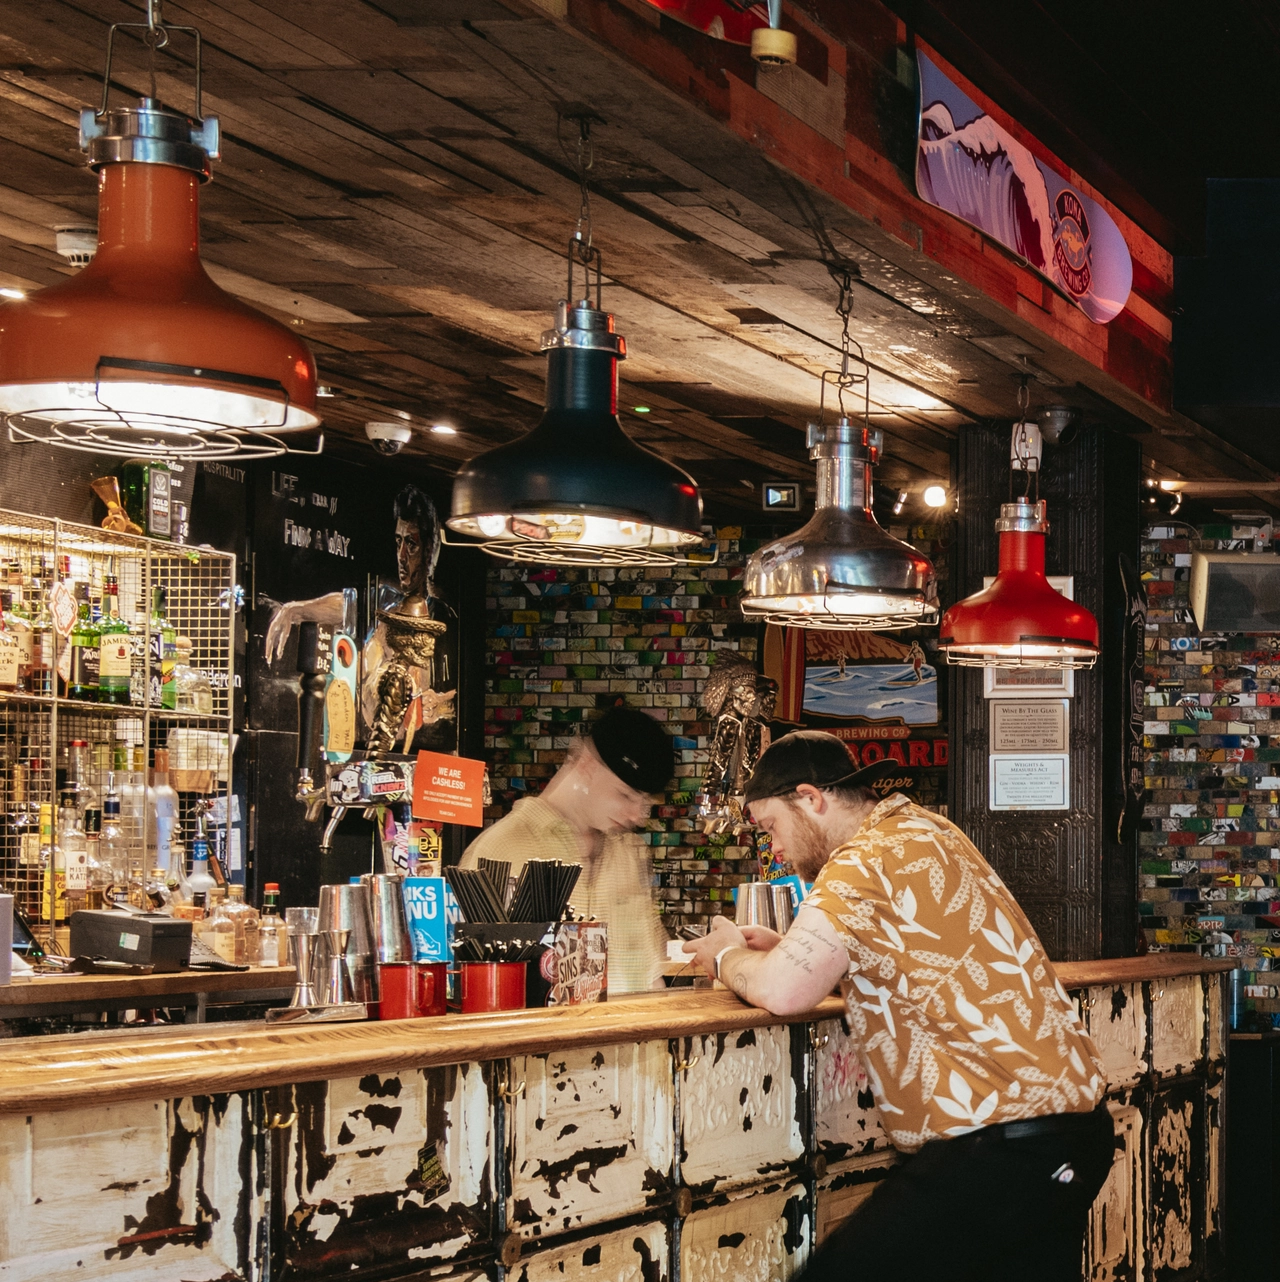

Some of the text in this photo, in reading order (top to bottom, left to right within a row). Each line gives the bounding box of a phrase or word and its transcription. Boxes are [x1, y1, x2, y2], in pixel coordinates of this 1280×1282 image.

[203, 460, 246, 484] HOSPITALITY
[152, 498, 169, 506] COLD
[836, 727, 889, 739] BREWING
[371, 773, 396, 785] REEL
[438, 766, 462, 779] WE ARE
[431, 776, 466, 790] CASHLESS!
[872, 776, 914, 795] ager
[559, 956, 579, 985] SINS
